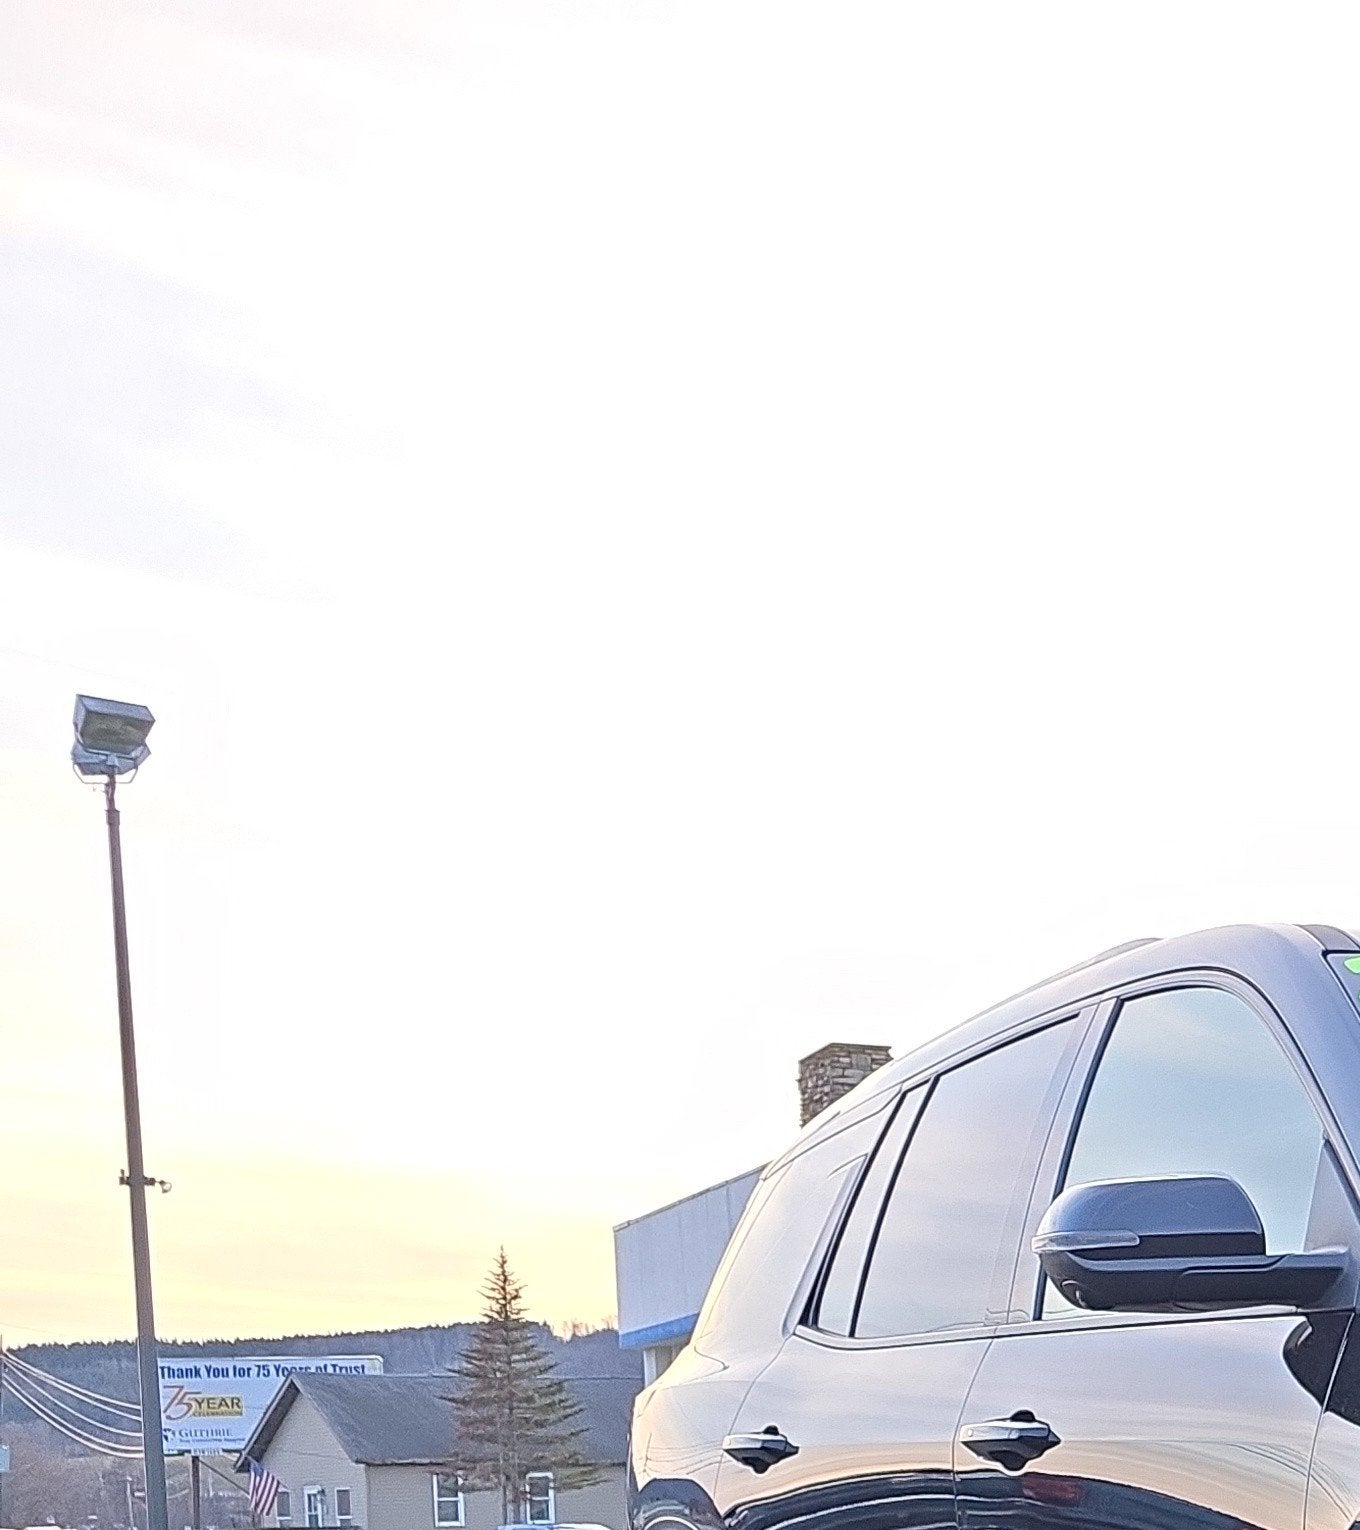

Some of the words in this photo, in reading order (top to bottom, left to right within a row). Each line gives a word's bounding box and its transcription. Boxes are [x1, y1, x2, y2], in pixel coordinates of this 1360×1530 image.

[159, 1365, 202, 1380] Thank
[204, 1363, 229, 1379] You
[232, 1364, 251, 1378] for
[254, 1364, 271, 1379] 75
[163, 1385, 202, 1420] 75
[193, 1396, 241, 1410] YEAR
